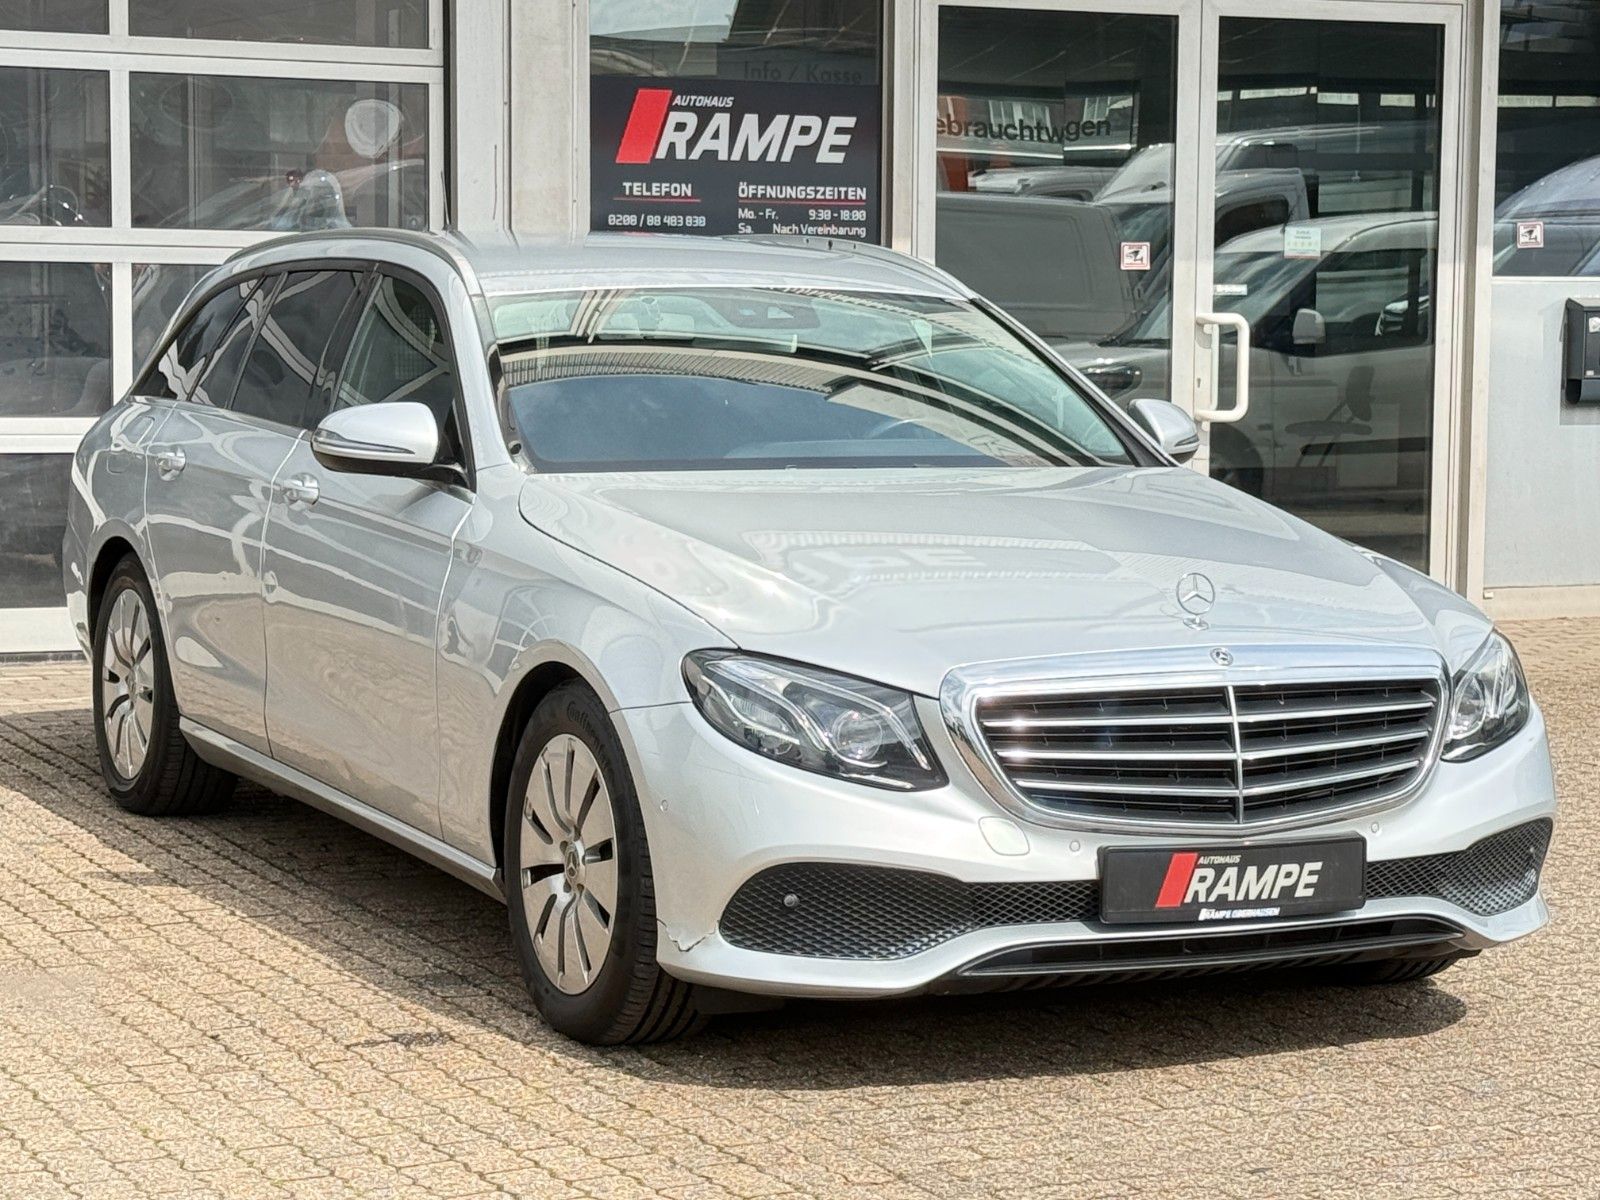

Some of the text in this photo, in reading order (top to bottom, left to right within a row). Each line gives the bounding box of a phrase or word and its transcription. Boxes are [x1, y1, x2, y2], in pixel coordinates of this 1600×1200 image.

[673, 95, 734, 107] AUTOHAUS
[655, 111, 857, 164] RAMPE
[623, 182, 691, 196] TELEFON
[738, 182, 866, 200] ÖFFNUNGSZEITEN
[765, 208, 779, 220] Fr.
[738, 223, 866, 238] Sa. Nach Vereinbarung
[1197, 855, 1241, 865] AUTOHAUS
[1184, 863, 1322, 903] RAMPE
